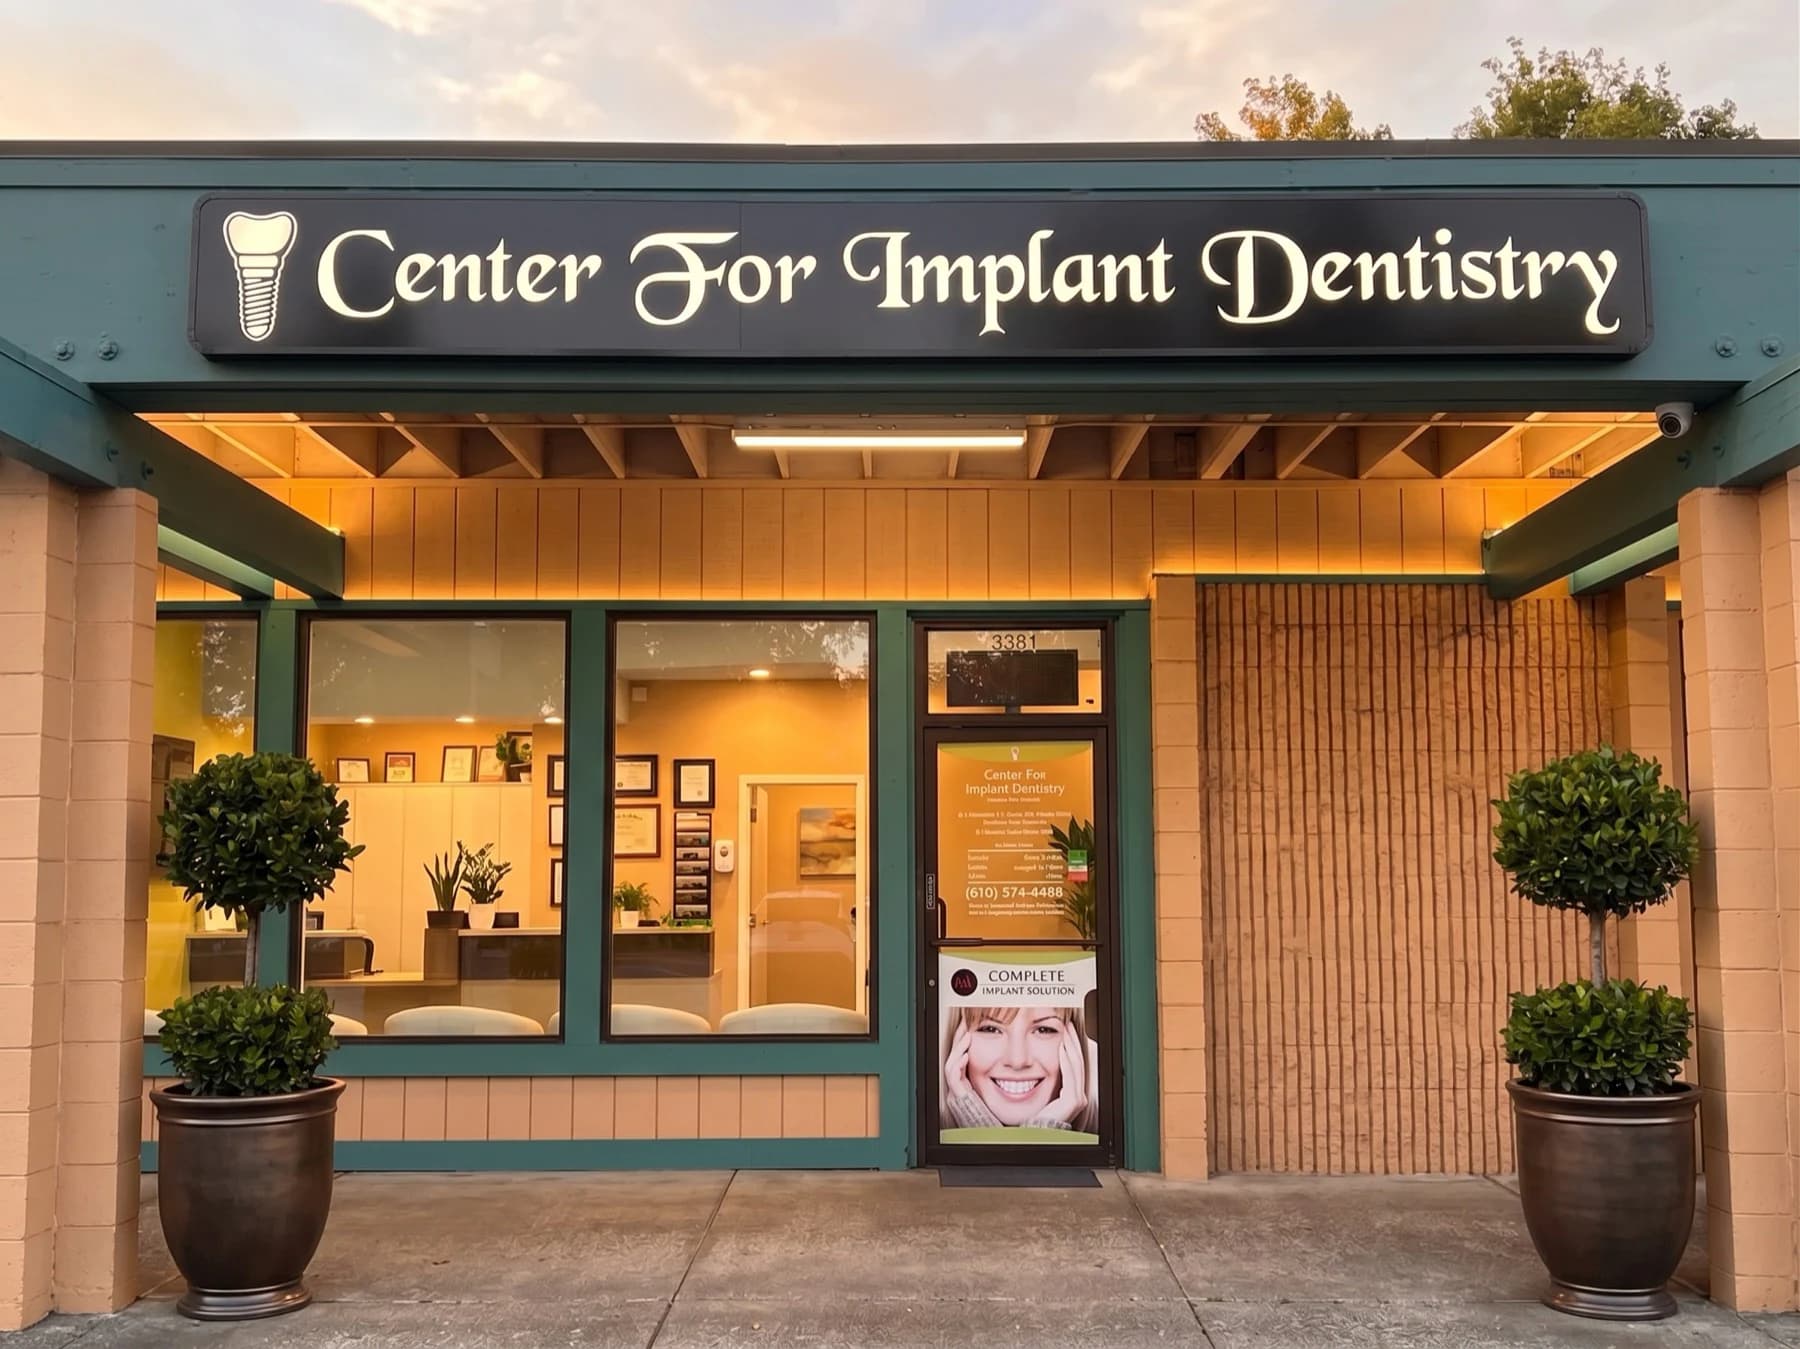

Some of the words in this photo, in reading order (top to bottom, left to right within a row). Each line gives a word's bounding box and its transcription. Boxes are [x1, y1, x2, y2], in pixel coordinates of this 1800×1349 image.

[317, 229, 602, 319] Center
[629, 231, 817, 326] For
[842, 229, 1176, 336] Implant
[1201, 228, 1620, 336] Dentistry
[991, 634, 1037, 650] 3381
[984, 769, 1022, 781] Center
[966, 784, 1009, 796] Implant
[1012, 784, 1065, 796] Dentistry
[965, 887, 998, 900] (610)
[1001, 887, 1064, 899] 574-4488
[988, 970, 1065, 983] COMPLETE
[982, 987, 1024, 996] IMPLANT
[1027, 987, 1076, 996] SOLUTION
